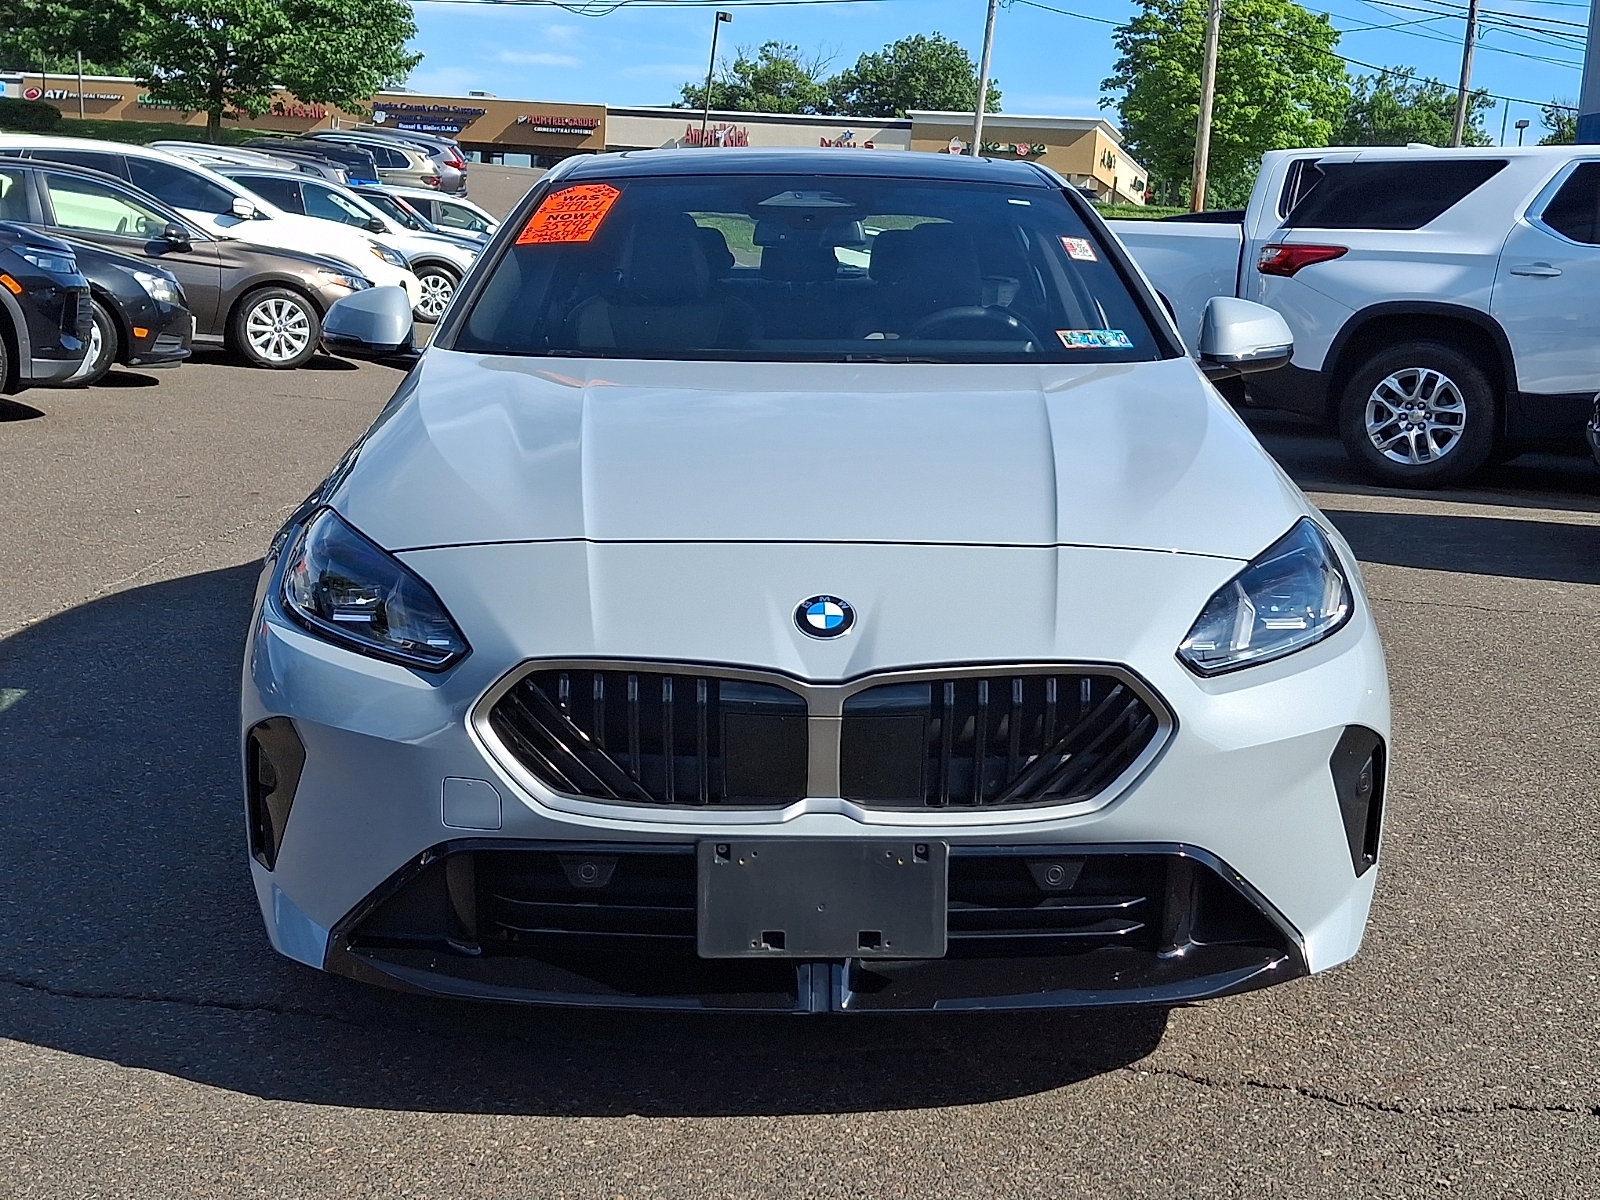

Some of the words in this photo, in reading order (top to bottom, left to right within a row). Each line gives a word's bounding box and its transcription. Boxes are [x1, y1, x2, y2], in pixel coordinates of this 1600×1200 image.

[44, 89, 68, 100] ATI
[400, 103, 431, 113] County
[433, 105, 450, 113] Oral
[452, 106, 485, 116] Surgery
[527, 115, 546, 124] PLUM
[547, 117, 565, 126] TREE
[568, 118, 597, 127] GARDEN
[563, 194, 600, 202] WAS
[546, 212, 590, 221] NOW
[802, 596, 850, 609] BMW
